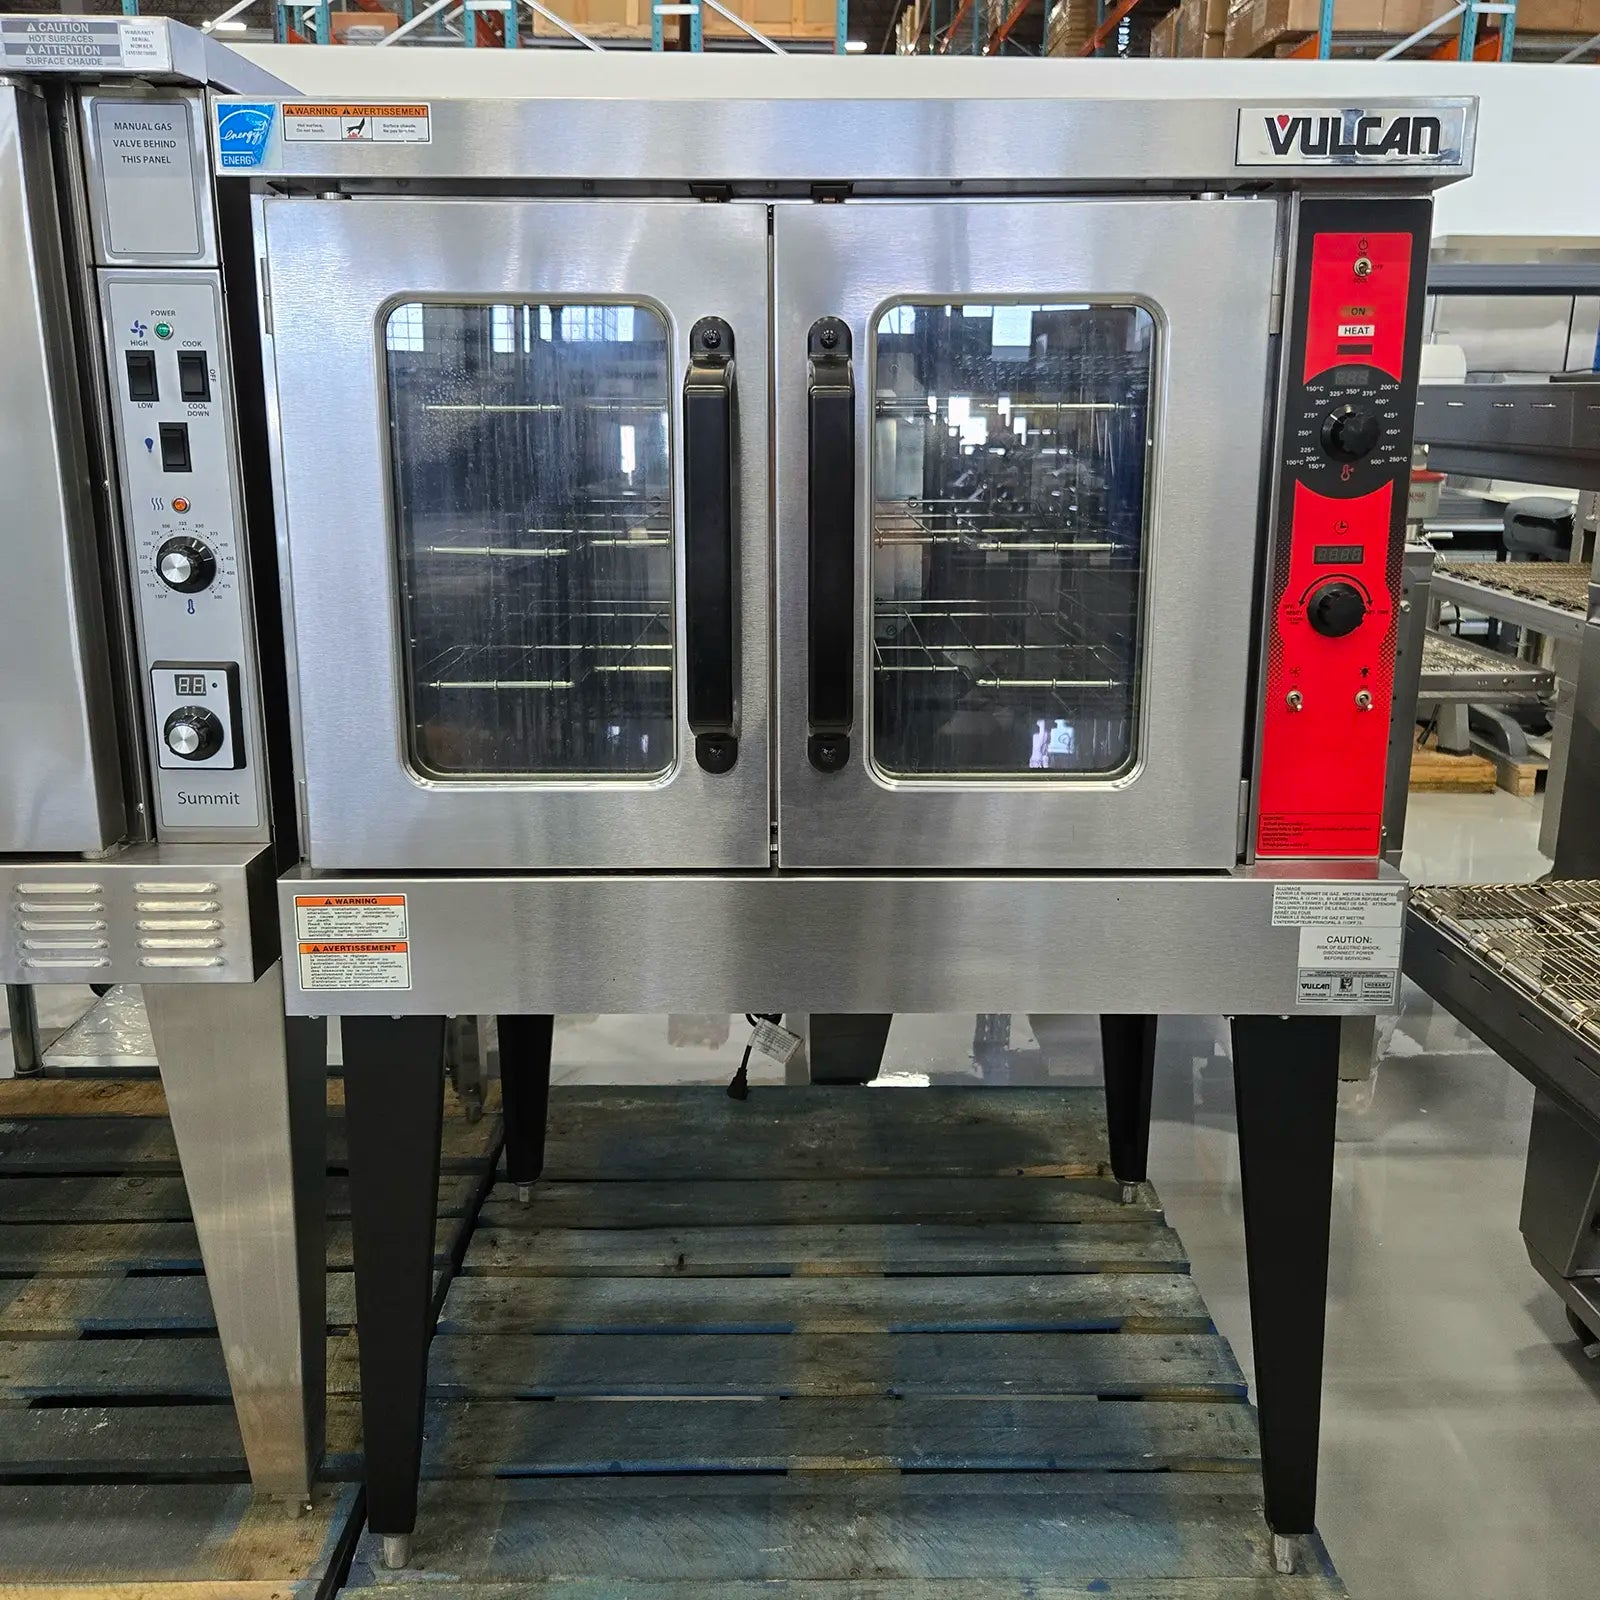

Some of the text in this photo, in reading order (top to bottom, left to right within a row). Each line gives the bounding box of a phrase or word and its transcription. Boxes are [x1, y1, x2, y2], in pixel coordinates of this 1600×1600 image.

[39, 23, 89, 33] CAUTION
[48, 35, 94, 43] SURFACES
[38, 45, 101, 55] ATTENTION
[26, 57, 65, 65] SURFACE
[68, 57, 103, 65] CHAUDE
[295, 107, 426, 116] WARNING AVERTISSEMENT
[154, 123, 172, 131] GAS
[1265, 115, 1440, 155] VULCAN
[143, 140, 176, 148] BEHIND
[143, 156, 171, 164] PANEL
[1344, 327, 1370, 335] HEAT
[177, 791, 240, 805] Summit
